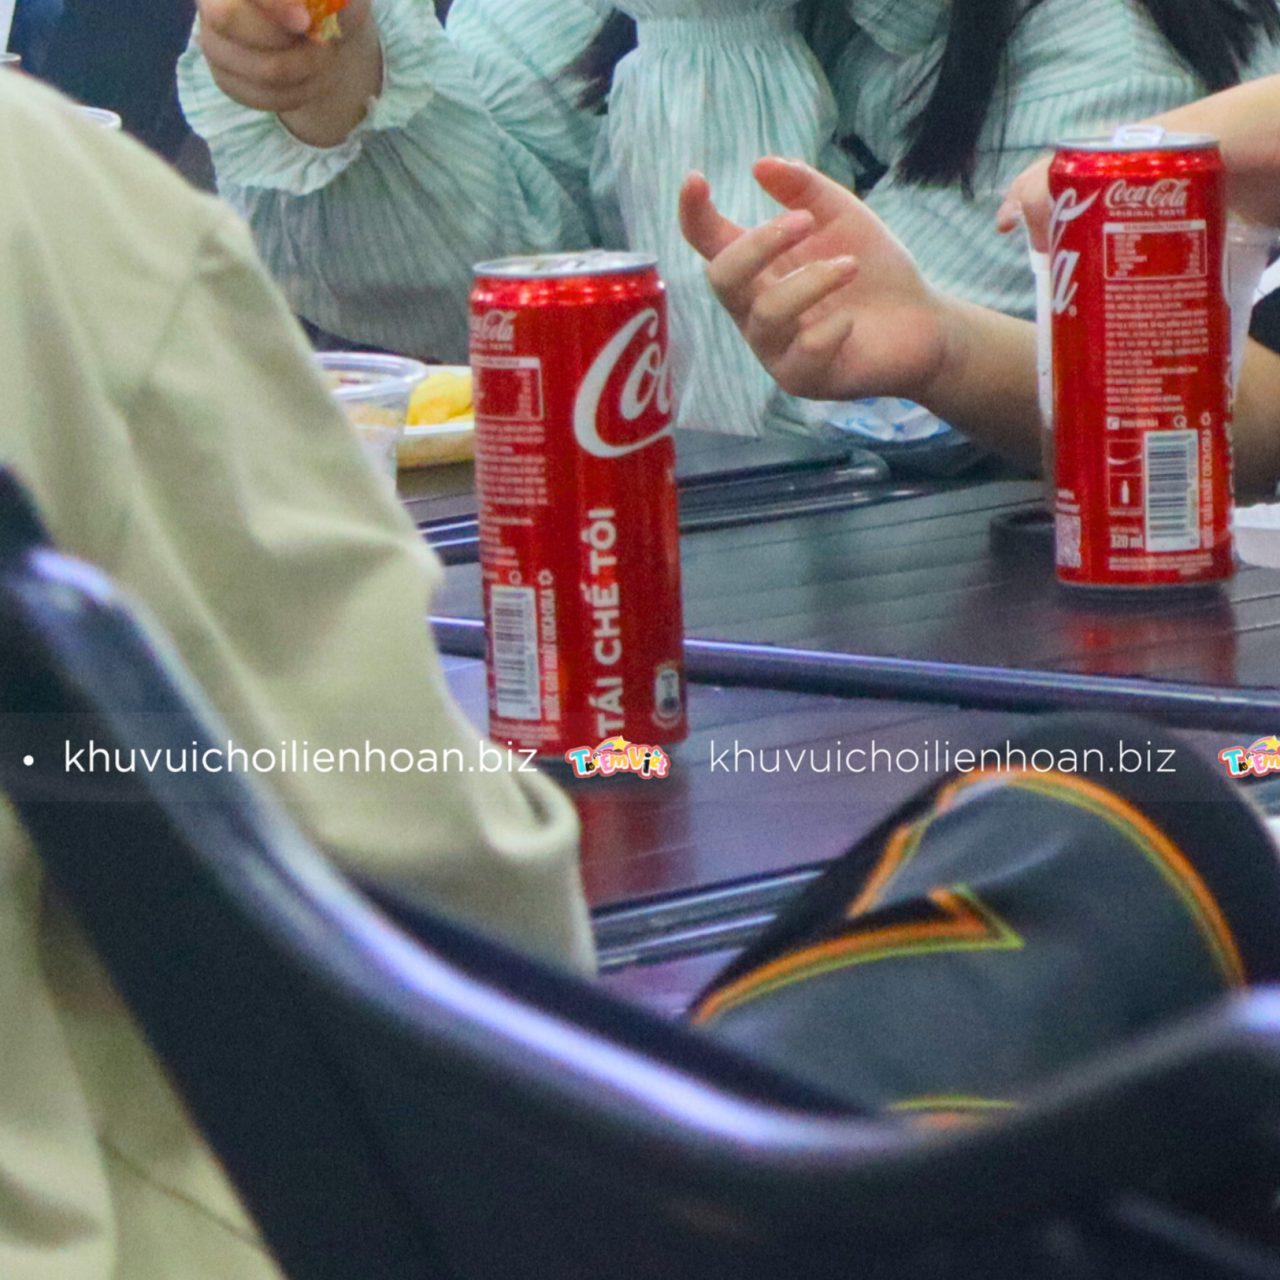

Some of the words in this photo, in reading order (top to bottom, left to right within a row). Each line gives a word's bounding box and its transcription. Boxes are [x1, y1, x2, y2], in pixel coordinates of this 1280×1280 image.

[580, 508, 617, 574] TÔI
[580, 582, 622, 665] CHẾ
[589, 677, 625, 737] TÁI
